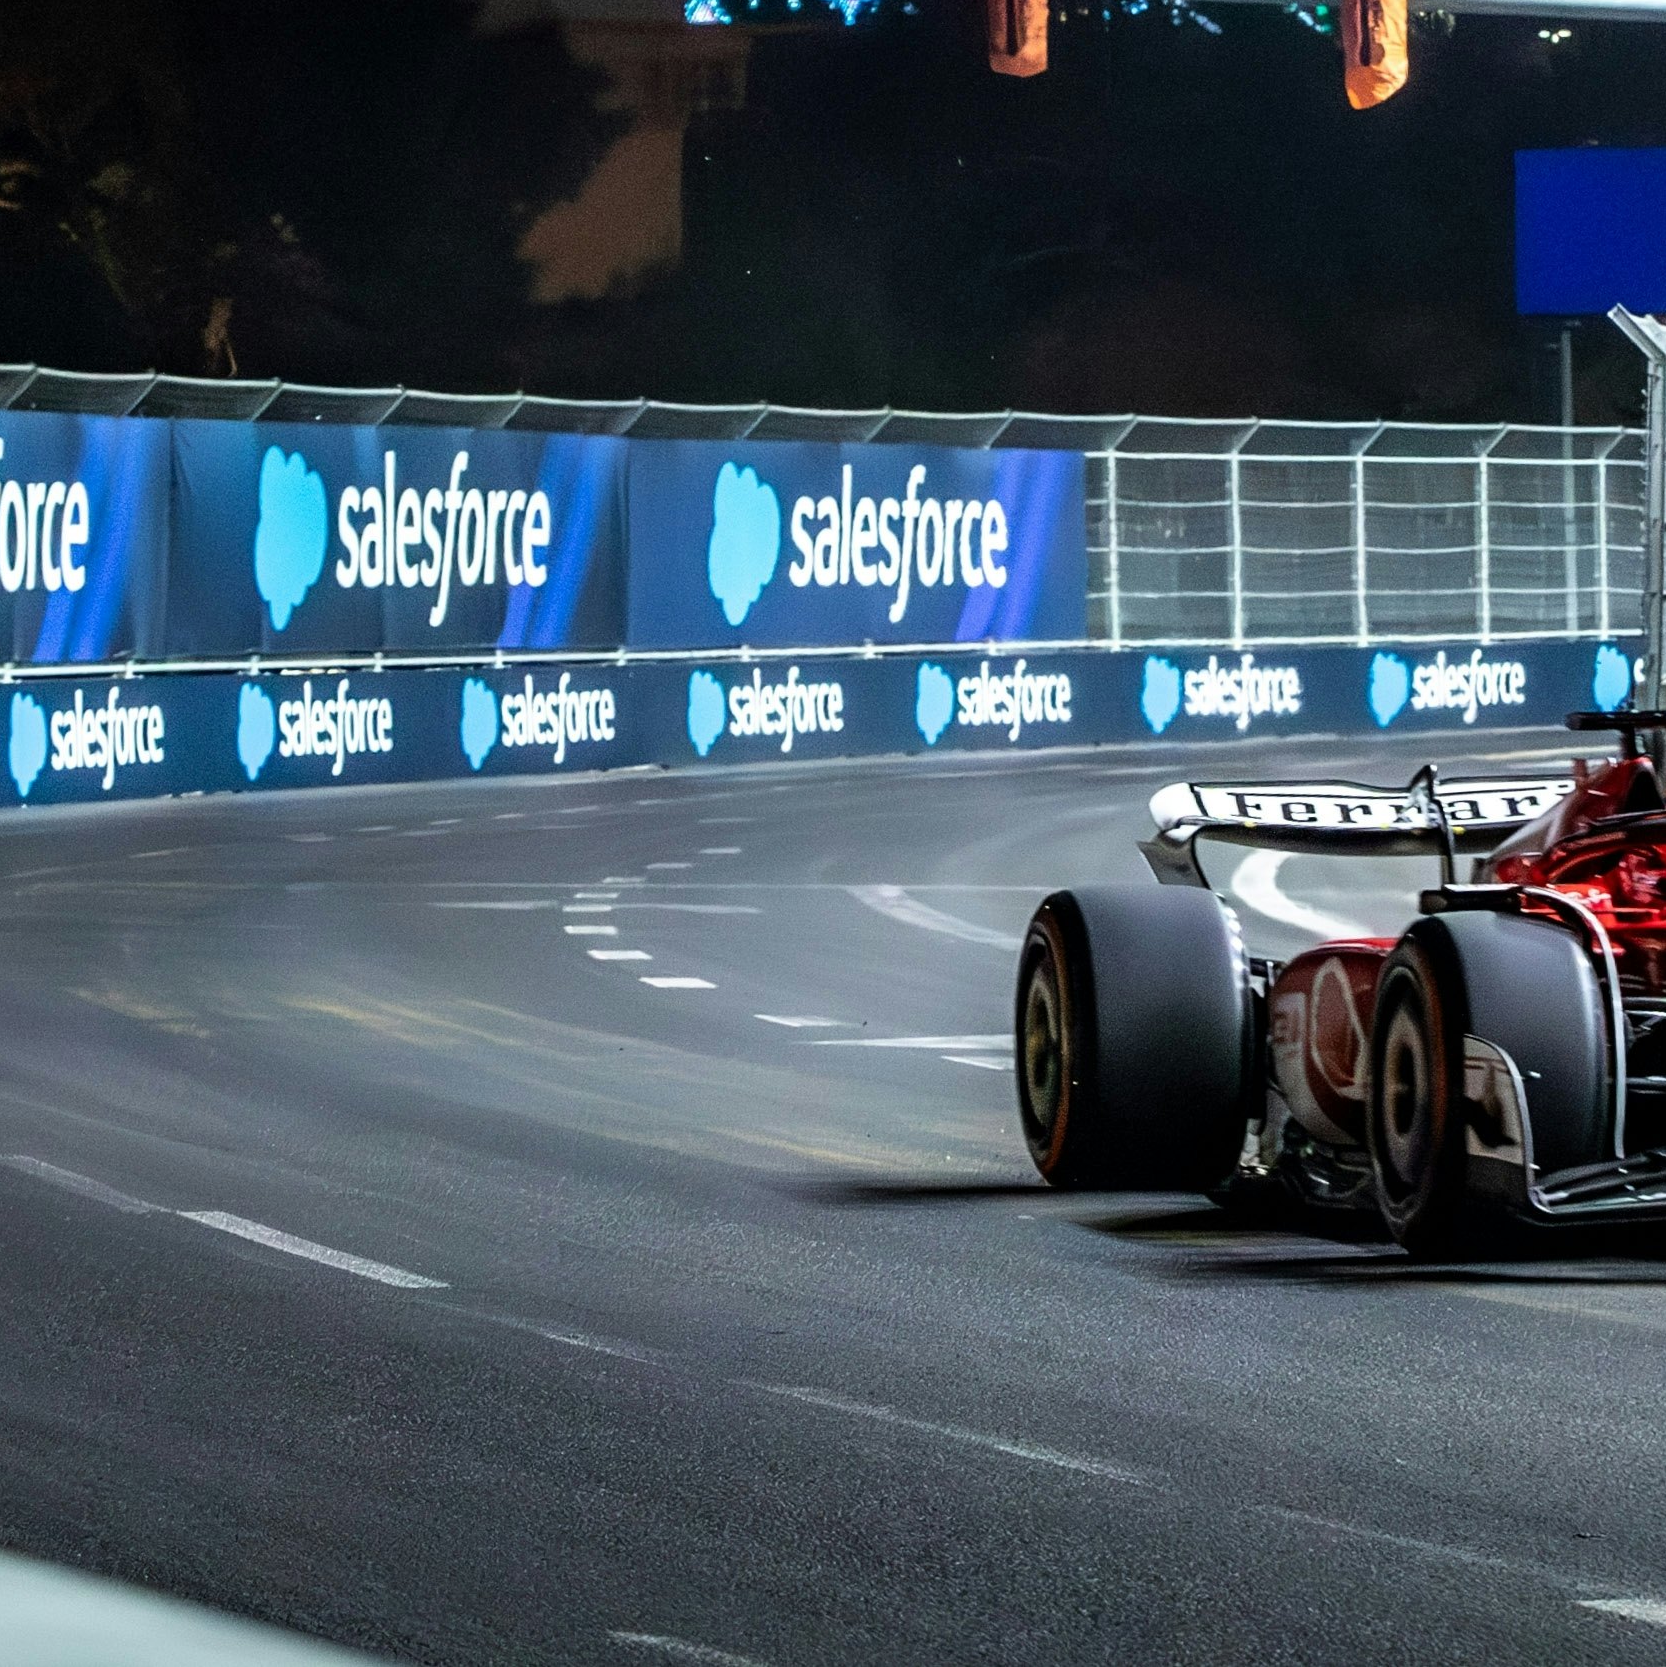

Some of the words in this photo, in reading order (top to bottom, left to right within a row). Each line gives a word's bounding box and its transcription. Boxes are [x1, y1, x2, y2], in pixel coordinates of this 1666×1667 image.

[335, 450, 552, 627] salesforce
[788, 463, 1009, 624] salesforce
[278, 679, 393, 776] salesforce
[501, 672, 616, 764] salesforce
[729, 665, 845, 753] salesforce
[957, 659, 1073, 742] salesforce
[1184, 653, 1301, 731] salesforce
[1411, 648, 1526, 725] salesforce
[50, 687, 165, 791] salesforce
